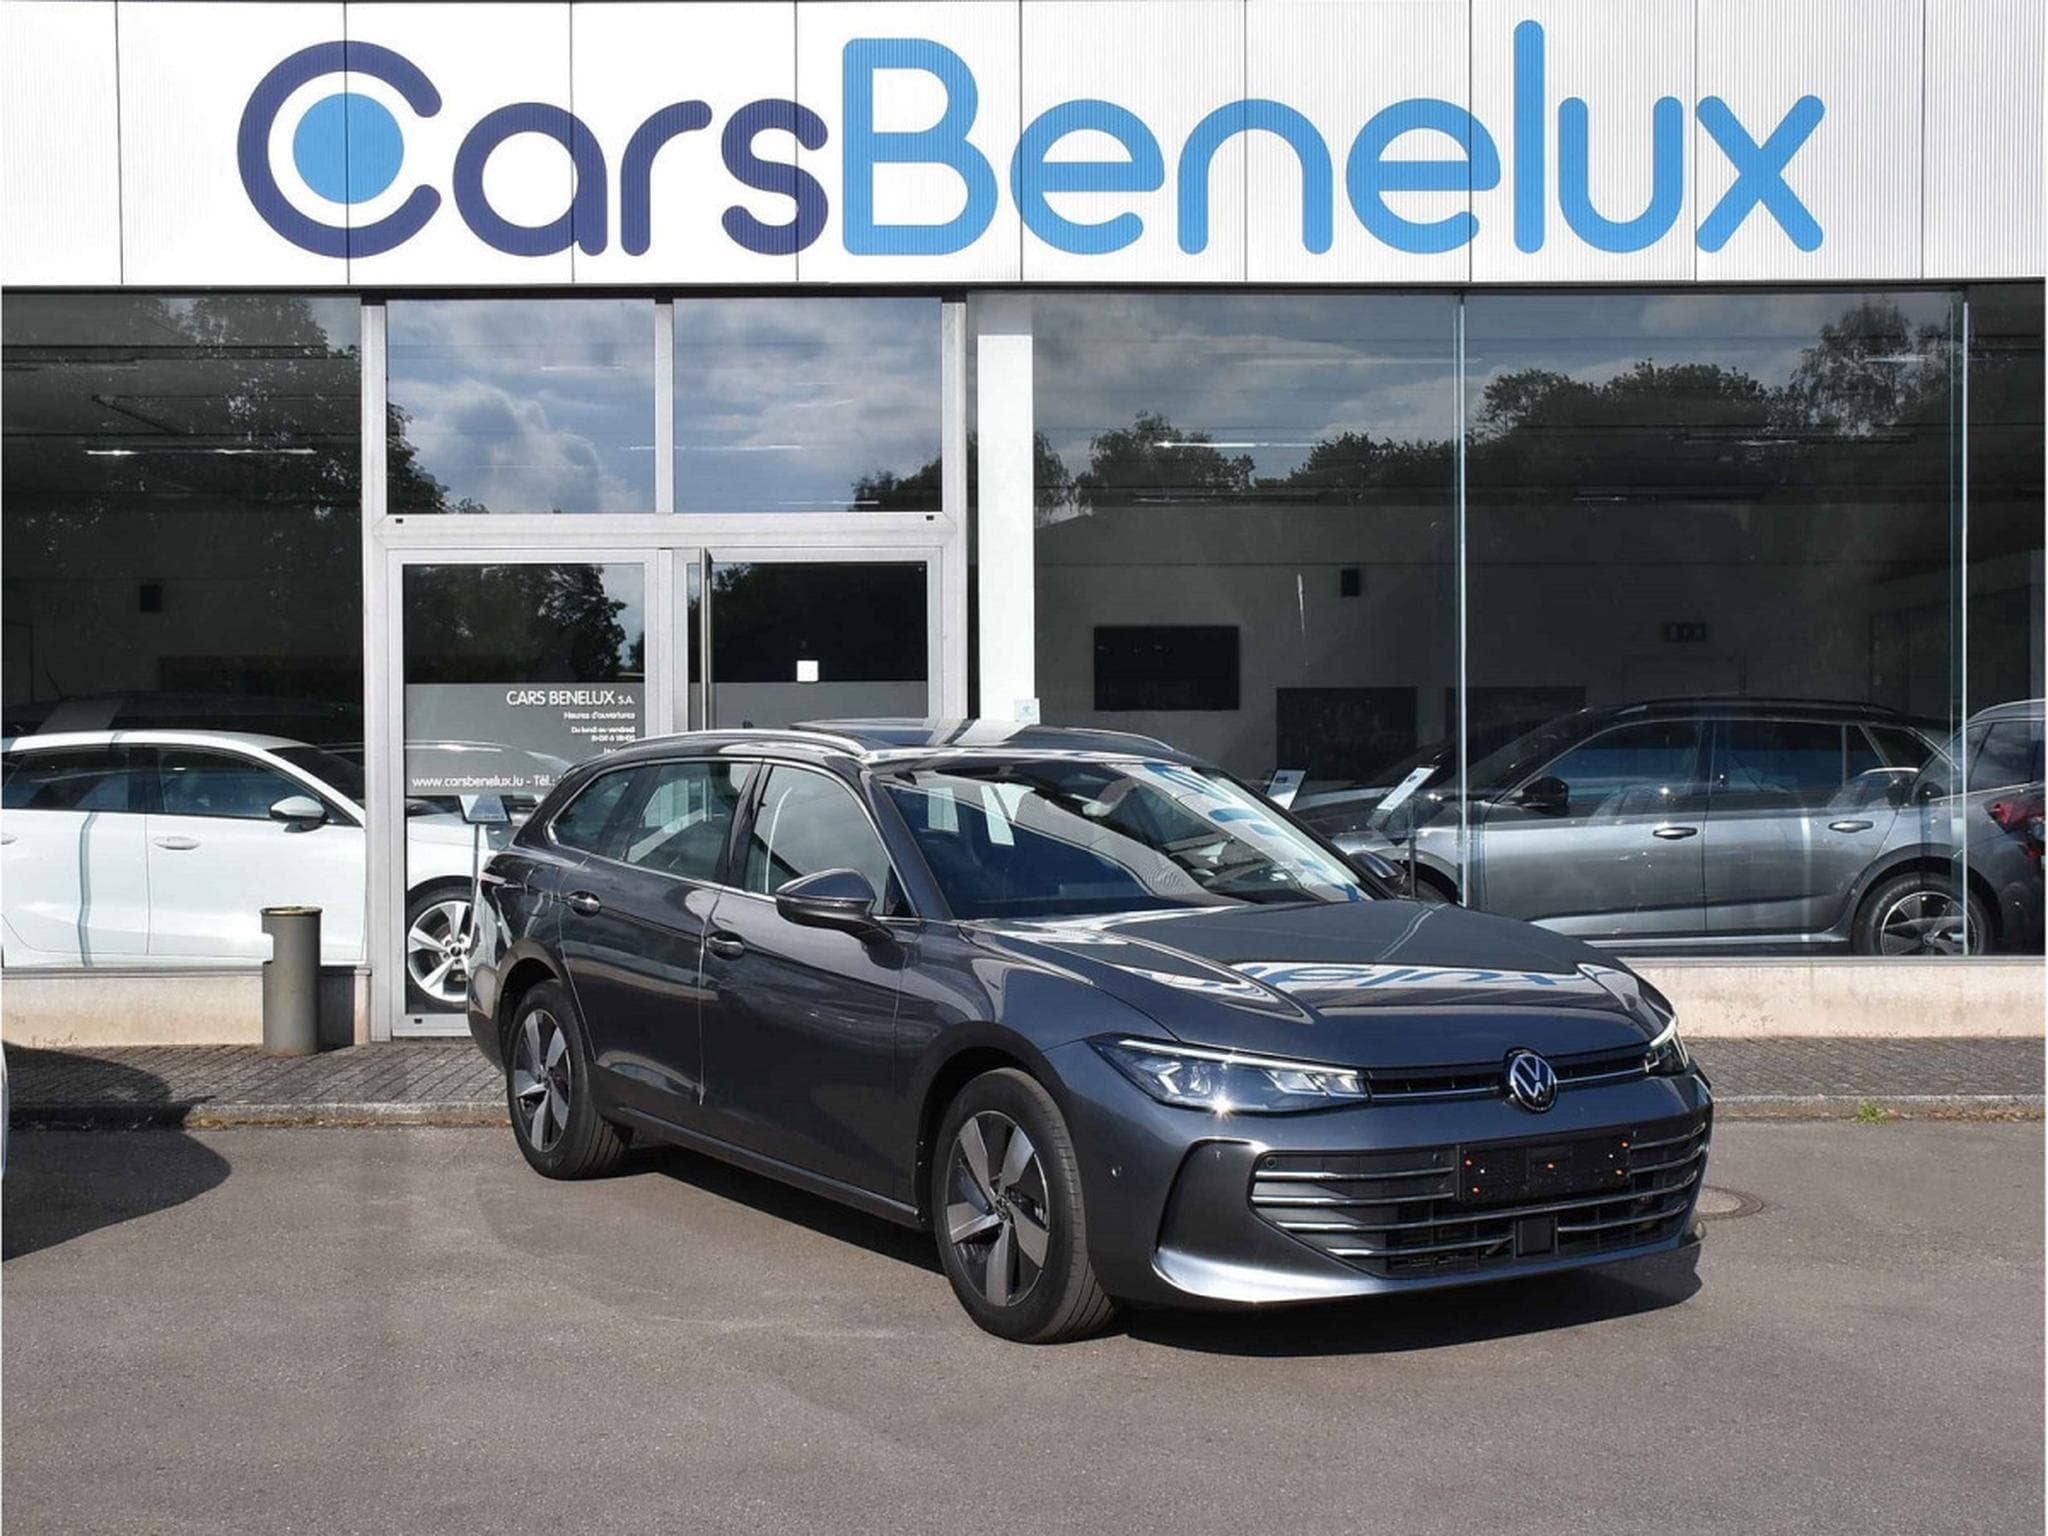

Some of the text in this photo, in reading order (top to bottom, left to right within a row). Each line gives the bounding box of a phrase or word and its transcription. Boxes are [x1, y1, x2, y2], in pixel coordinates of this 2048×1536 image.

[237, 20, 1825, 258] CarsBenelux
[506, 690, 546, 705] CARS
[548, 690, 616, 705] BENELUX
[411, 775, 524, 788] www.carsbenelux.lu
